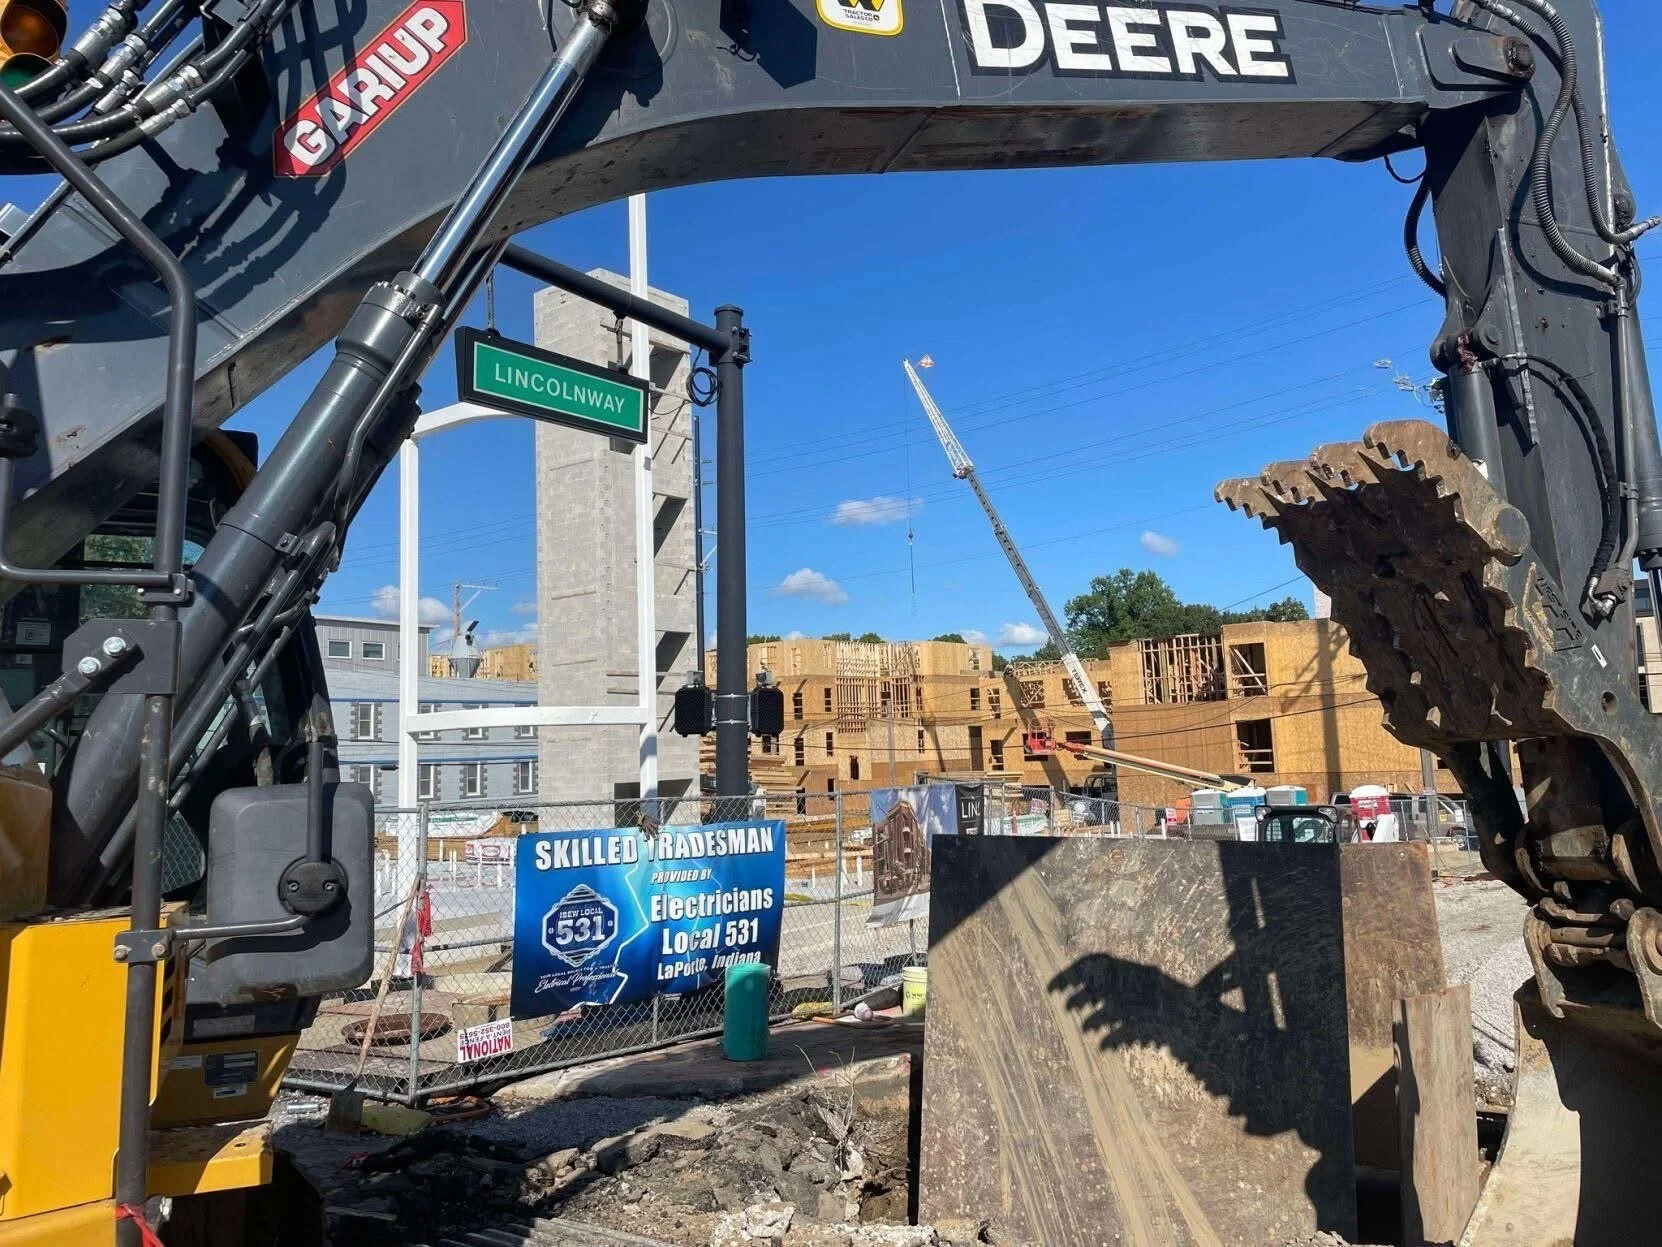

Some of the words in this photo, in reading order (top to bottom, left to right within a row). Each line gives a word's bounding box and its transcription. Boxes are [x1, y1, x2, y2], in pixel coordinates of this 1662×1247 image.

[842, 8, 873, 17] TRACTOR
[962, 0, 1290, 78] DEERE
[284, 7, 450, 167] GARIUP
[495, 363, 625, 414] LINCOLNWAY
[1072, 668, 1088, 694] TEREX
[535, 834, 639, 871] SKILLED
[645, 826, 774, 862] TRADESMAN
[651, 868, 699, 885] PROVIDED
[700, 867, 712, 880] BY
[559, 910, 579, 919] IBEW
[580, 907, 604, 916] LOCAL
[650, 887, 773, 923] Electricians
[555, 915, 606, 945] 531
[662, 923, 721, 955] Local
[725, 917, 759, 947] 531
[657, 957, 708, 981] LaPorte,
[711, 950, 761, 970] Indiana
[460, 1034, 511, 1061] NATIONAL
